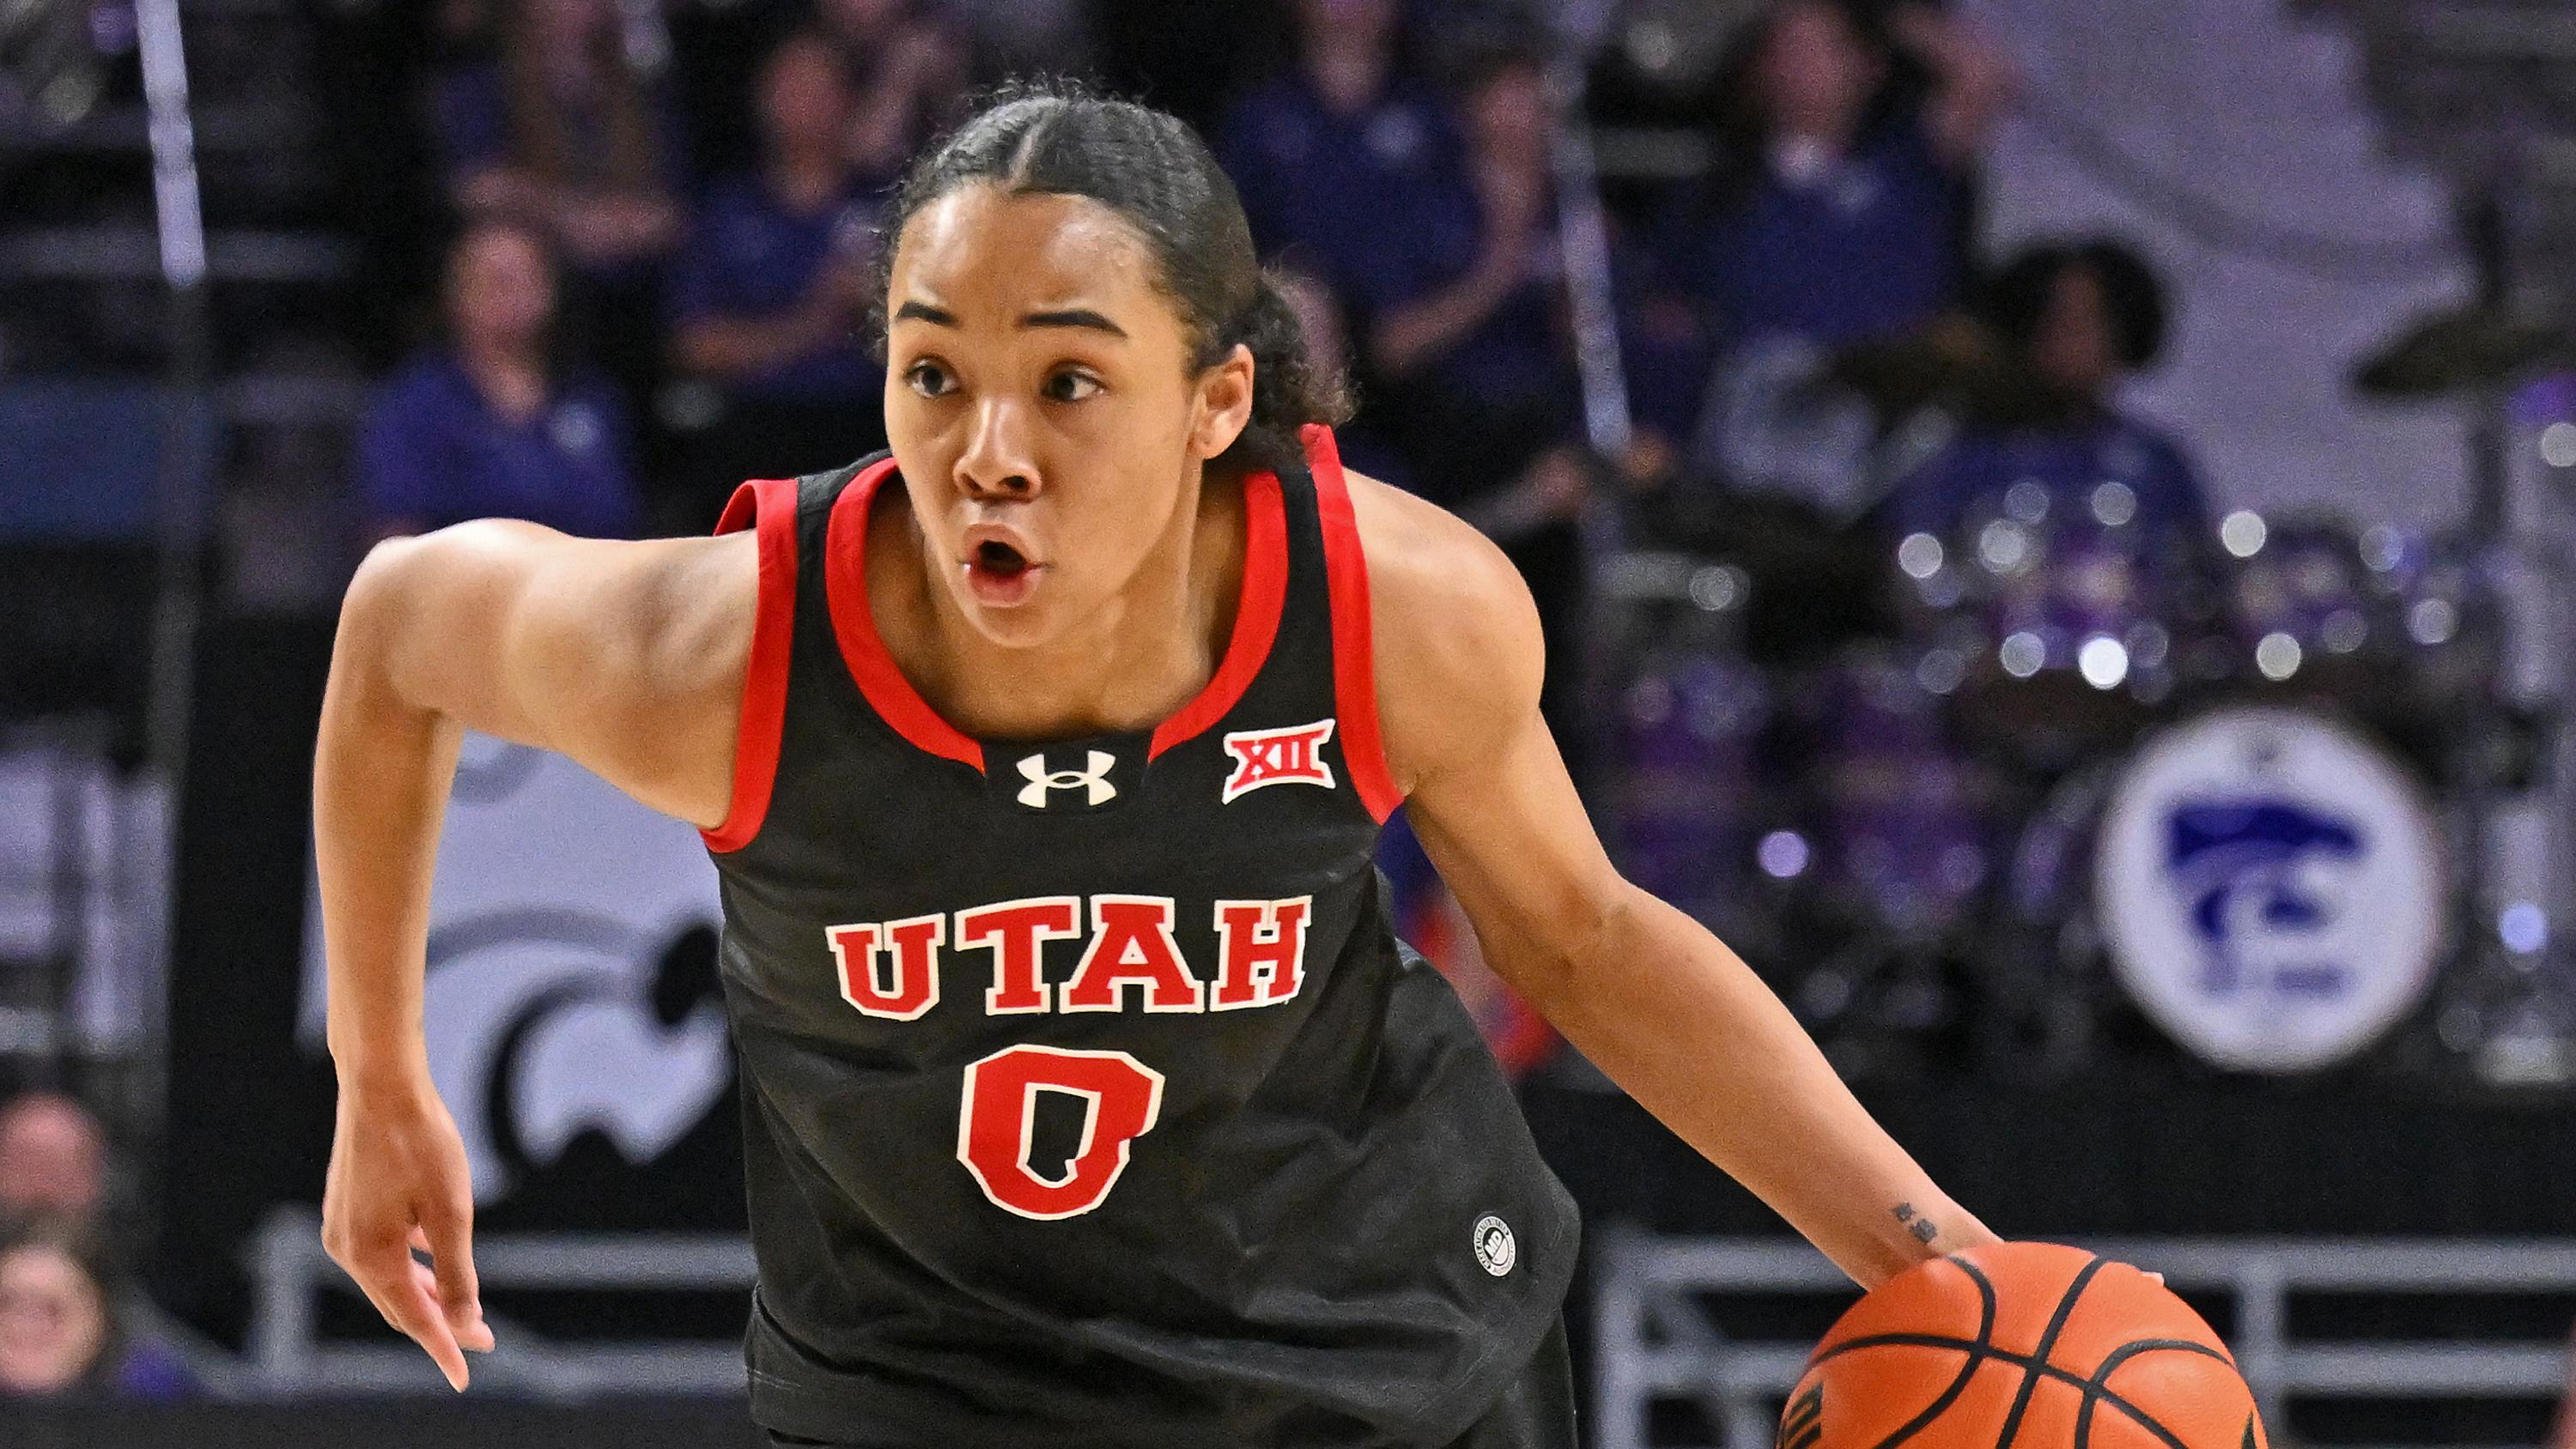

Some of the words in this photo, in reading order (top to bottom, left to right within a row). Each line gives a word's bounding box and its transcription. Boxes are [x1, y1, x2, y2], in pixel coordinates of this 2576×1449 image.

[1224, 721, 1334, 800] XII
[825, 894, 1313, 1022] UTAH
[957, 1044, 1165, 1221] 0
